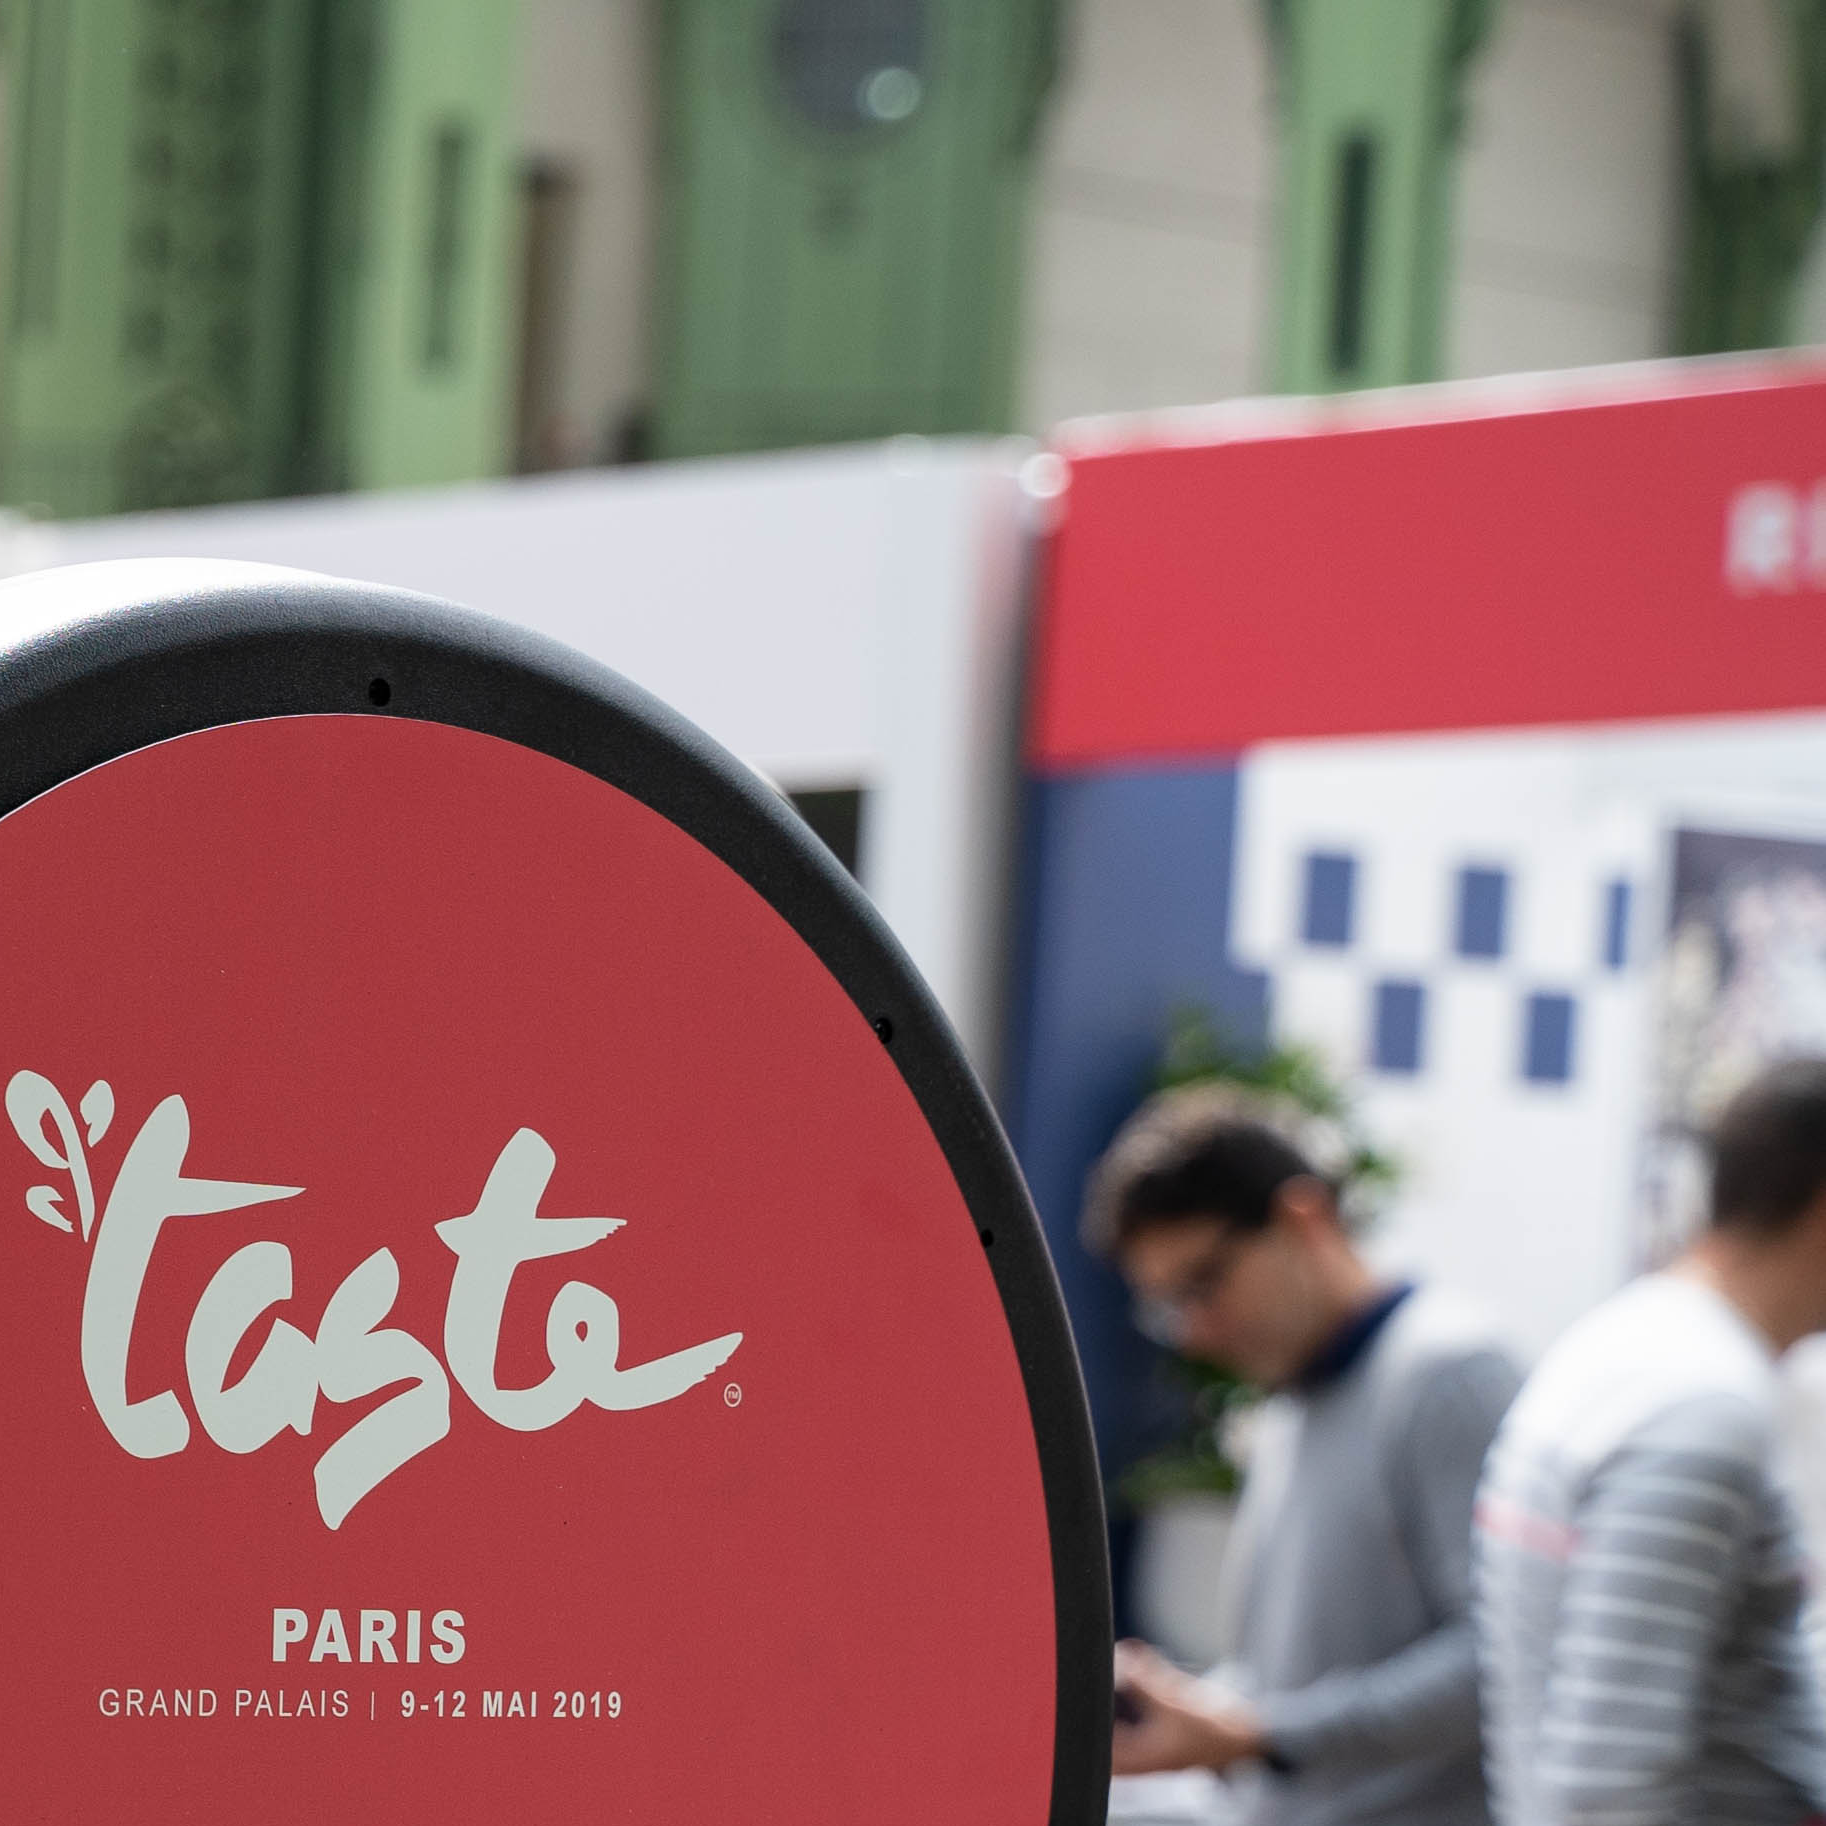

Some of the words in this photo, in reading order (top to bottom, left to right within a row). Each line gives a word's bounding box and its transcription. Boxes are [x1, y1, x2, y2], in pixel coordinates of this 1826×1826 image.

[79, 1092, 744, 1531] taste
[272, 1607, 467, 1665] PARIS
[98, 1687, 218, 1719] GRAND
[234, 1687, 350, 1719] PALAIS
[400, 1689, 467, 1719] 9-12
[482, 1689, 538, 1719] MAI
[552, 1690, 623, 1719] 2019
